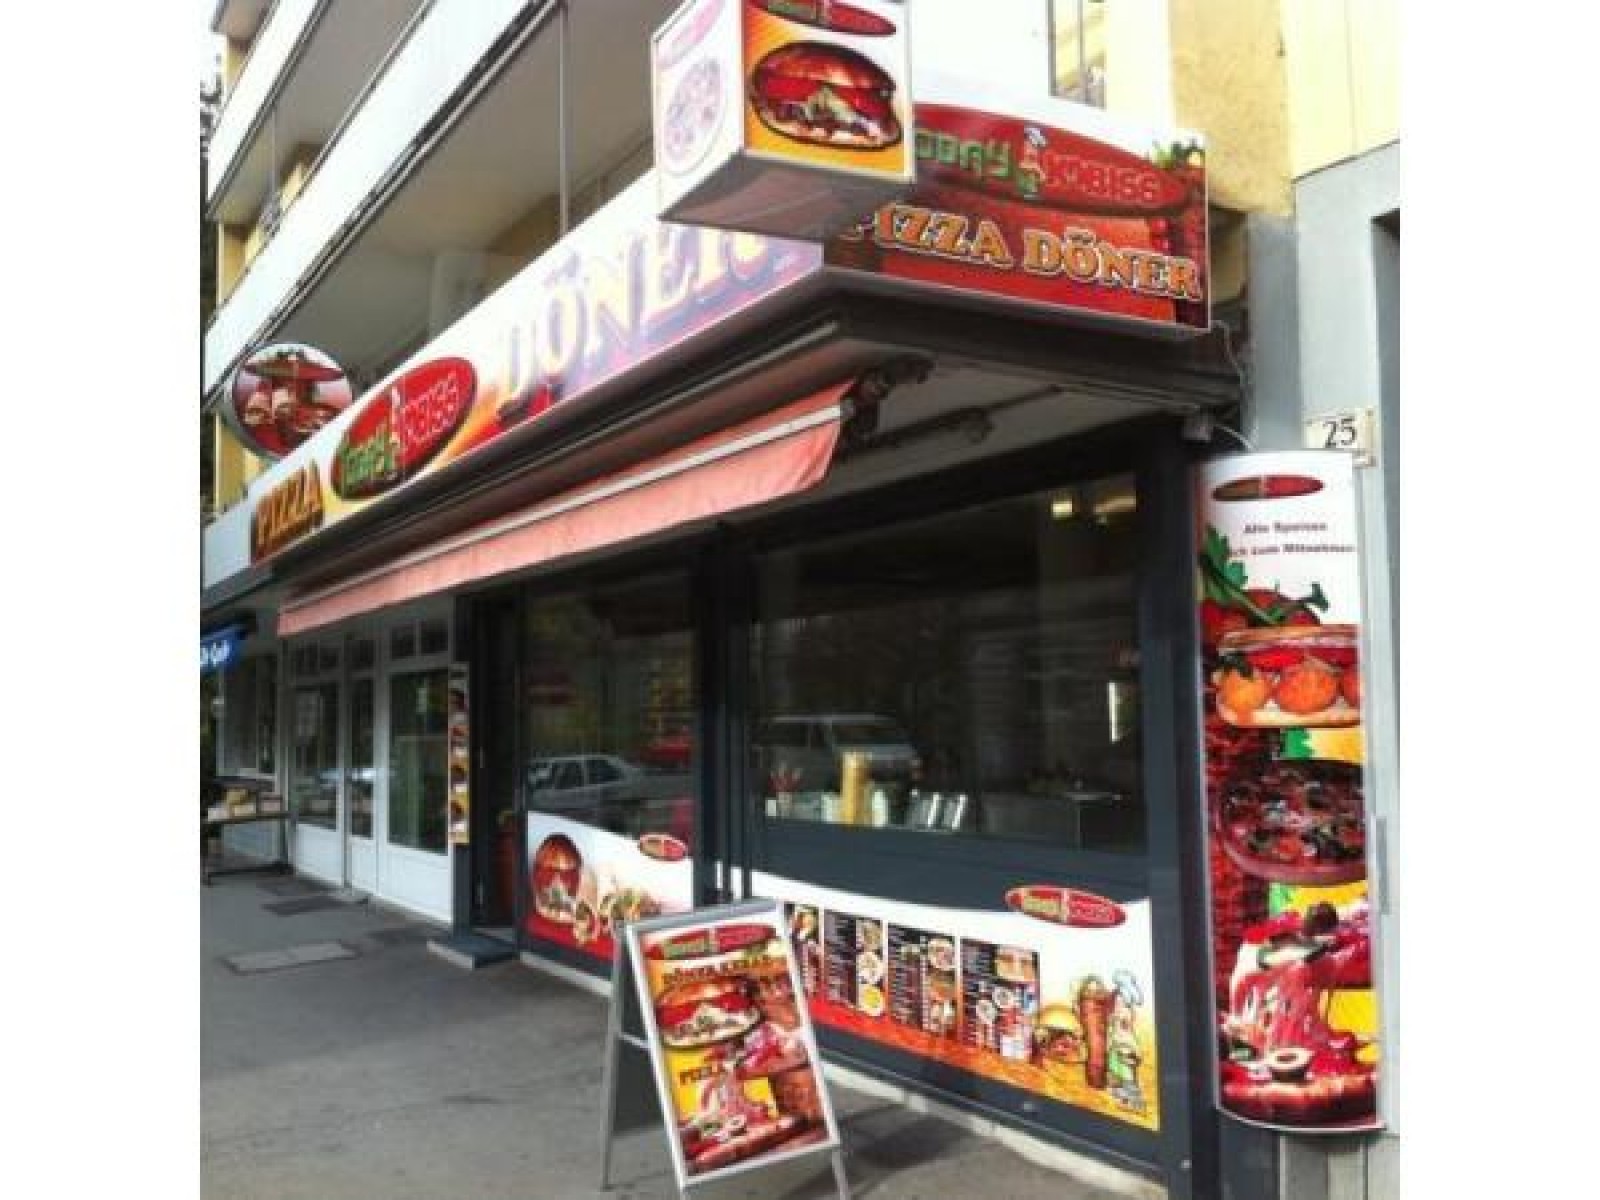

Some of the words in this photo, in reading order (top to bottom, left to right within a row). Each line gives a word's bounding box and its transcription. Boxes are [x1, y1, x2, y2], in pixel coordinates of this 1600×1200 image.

[840, 203, 1014, 270] IZZA
[1022, 225, 1201, 301] DÖNER
[1323, 415, 1357, 449] 25
[254, 460, 323, 548] PIZZA
